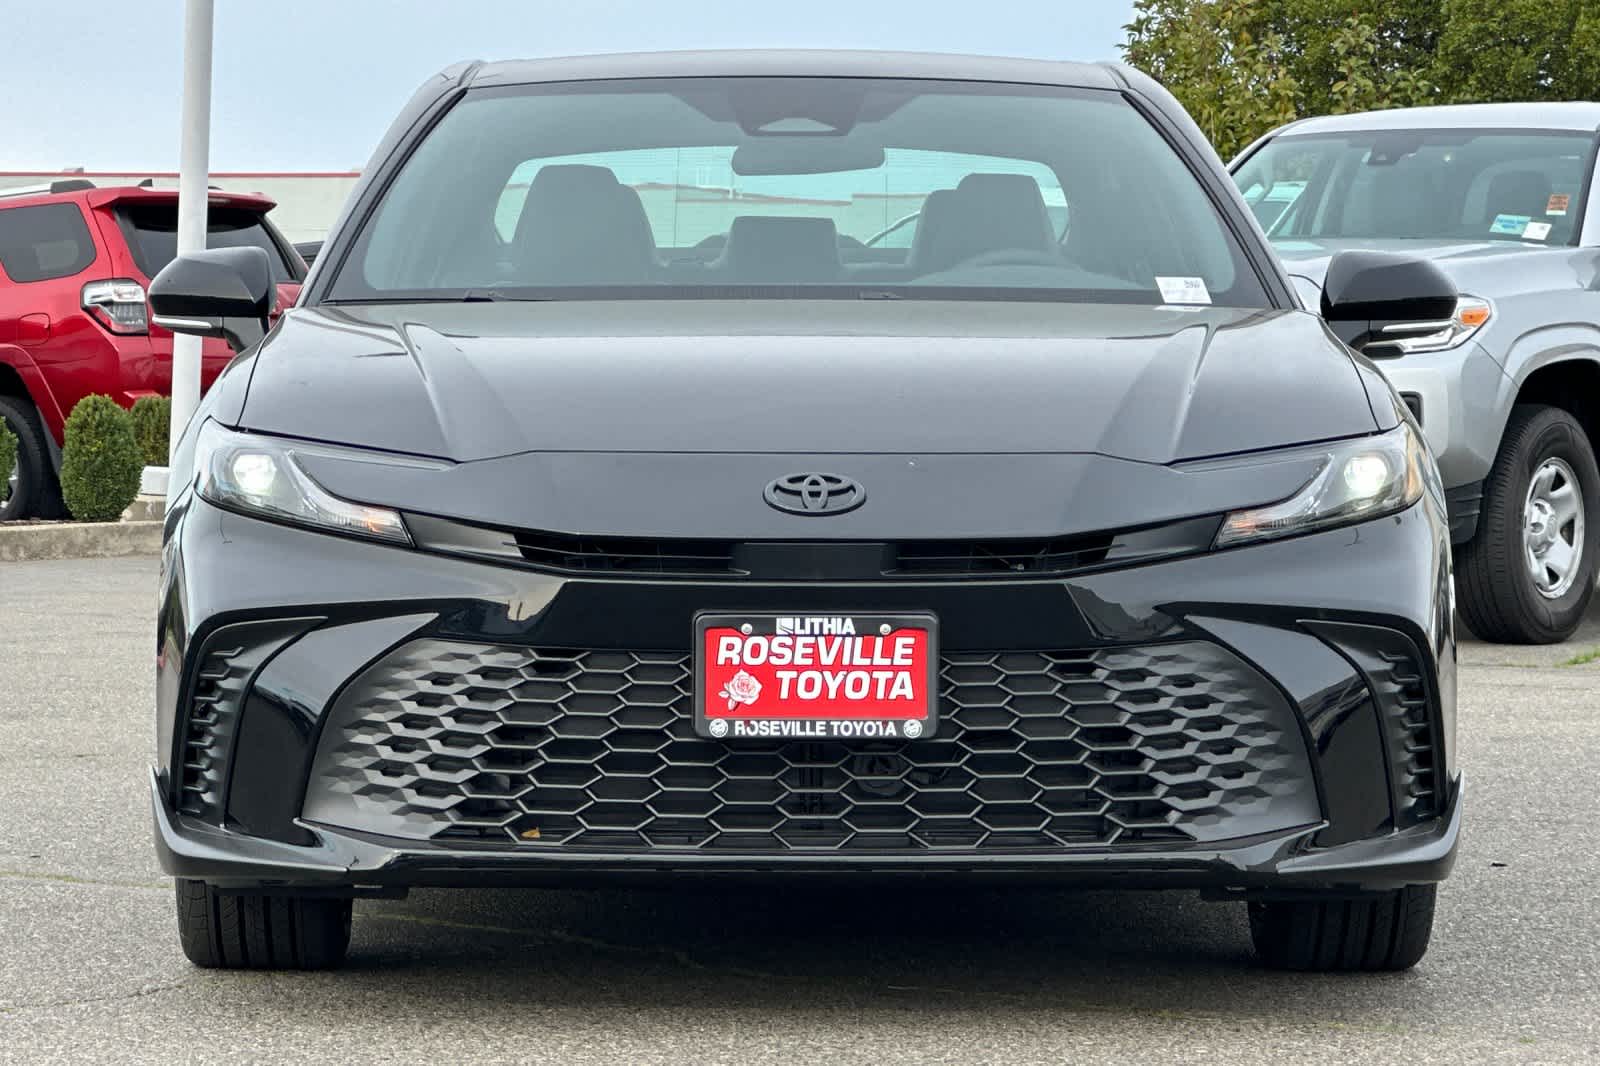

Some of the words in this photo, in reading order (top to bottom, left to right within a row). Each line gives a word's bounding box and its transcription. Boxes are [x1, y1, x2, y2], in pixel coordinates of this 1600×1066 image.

[794, 618, 856, 635] LITHIA
[717, 636, 915, 666] ROSEVILLE
[775, 670, 914, 700] TOYOTA
[734, 720, 827, 736] ROSEVILLE
[830, 720, 897, 736] TOYOTA
